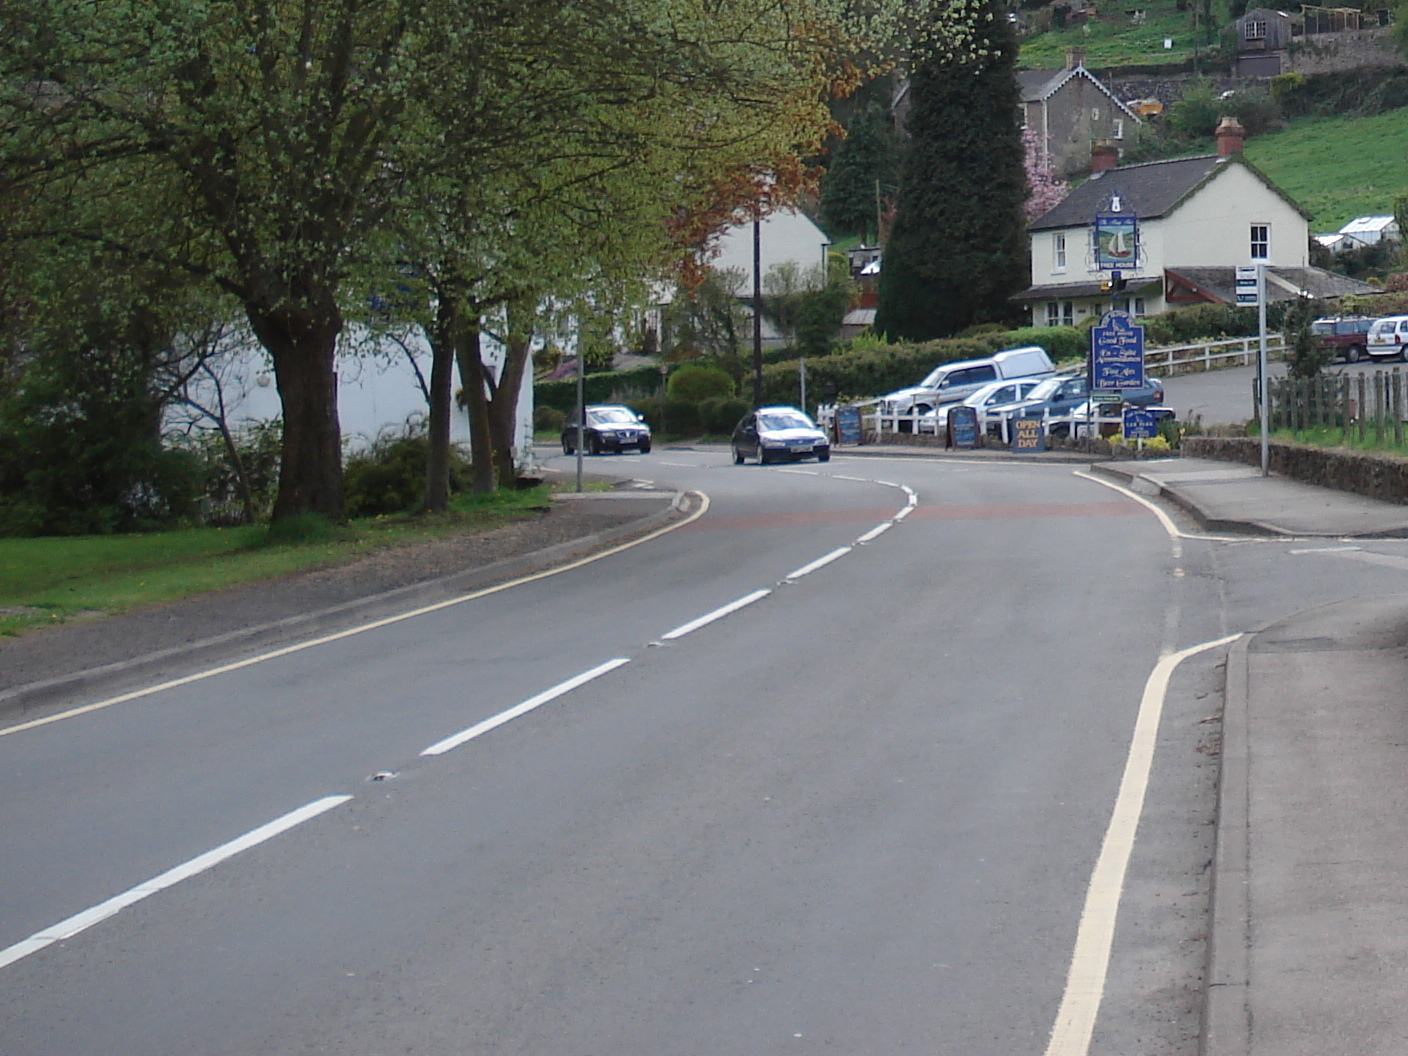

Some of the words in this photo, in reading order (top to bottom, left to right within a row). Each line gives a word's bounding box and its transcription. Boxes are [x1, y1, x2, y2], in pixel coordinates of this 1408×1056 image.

[1098, 336, 1117, 345] Good
[1118, 336, 1137, 345] Food
[1016, 419, 1040, 430] OPEN
[1017, 429, 1039, 439] ALL
[1018, 438, 1038, 448] DAY
